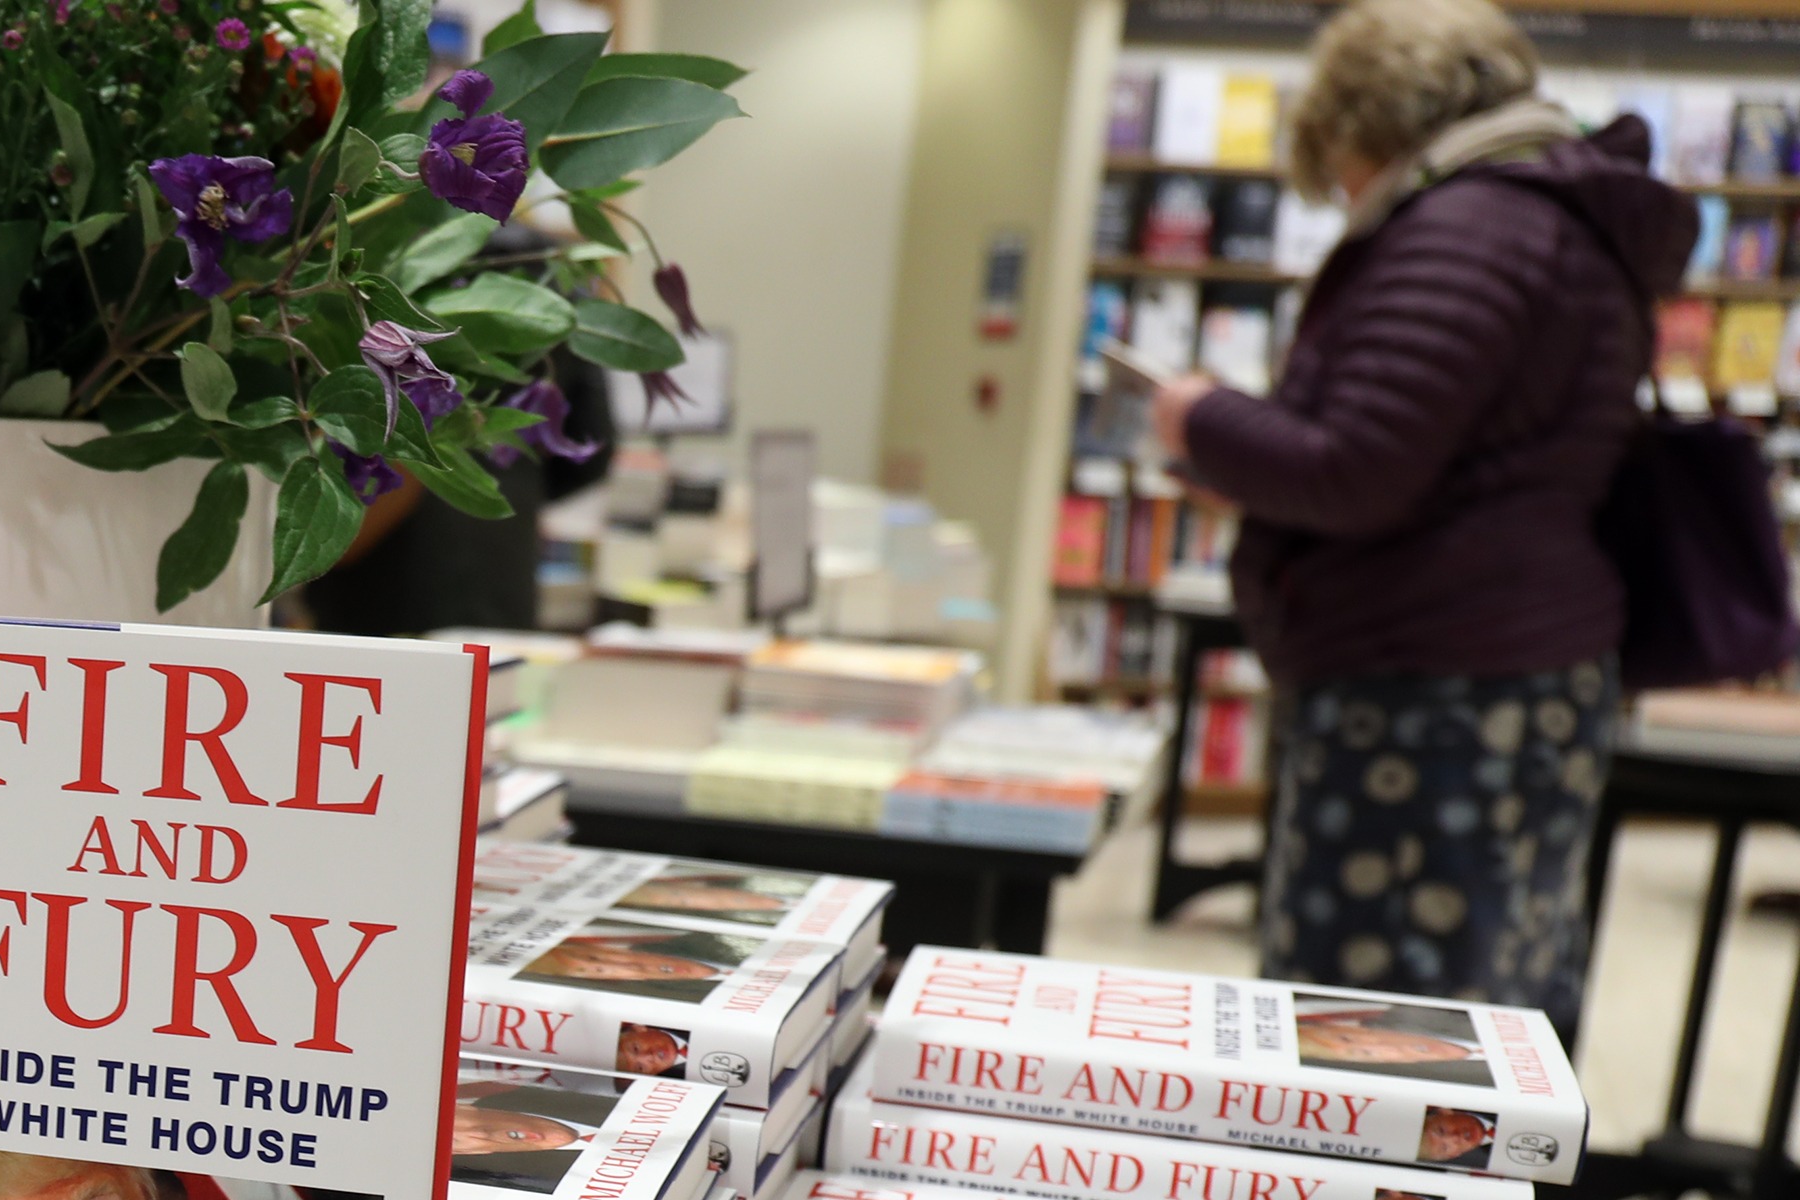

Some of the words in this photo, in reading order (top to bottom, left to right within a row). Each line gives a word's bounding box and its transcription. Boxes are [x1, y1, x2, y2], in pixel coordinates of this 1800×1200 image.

[66, 816, 248, 884] AND
[913, 956, 1026, 1027] FIRE
[1088, 969, 1191, 1049] FURY
[459, 1000, 574, 1055] URY
[97, 1060, 190, 1100] THE
[212, 1073, 389, 1122] TRUMP
[637, 1080, 692, 1127] WOLFF
[916, 1042, 1044, 1095] FIRE
[1064, 1062, 1195, 1111] AND
[1216, 1079, 1375, 1136] FURY
[151, 1117, 317, 1168] HOUSE
